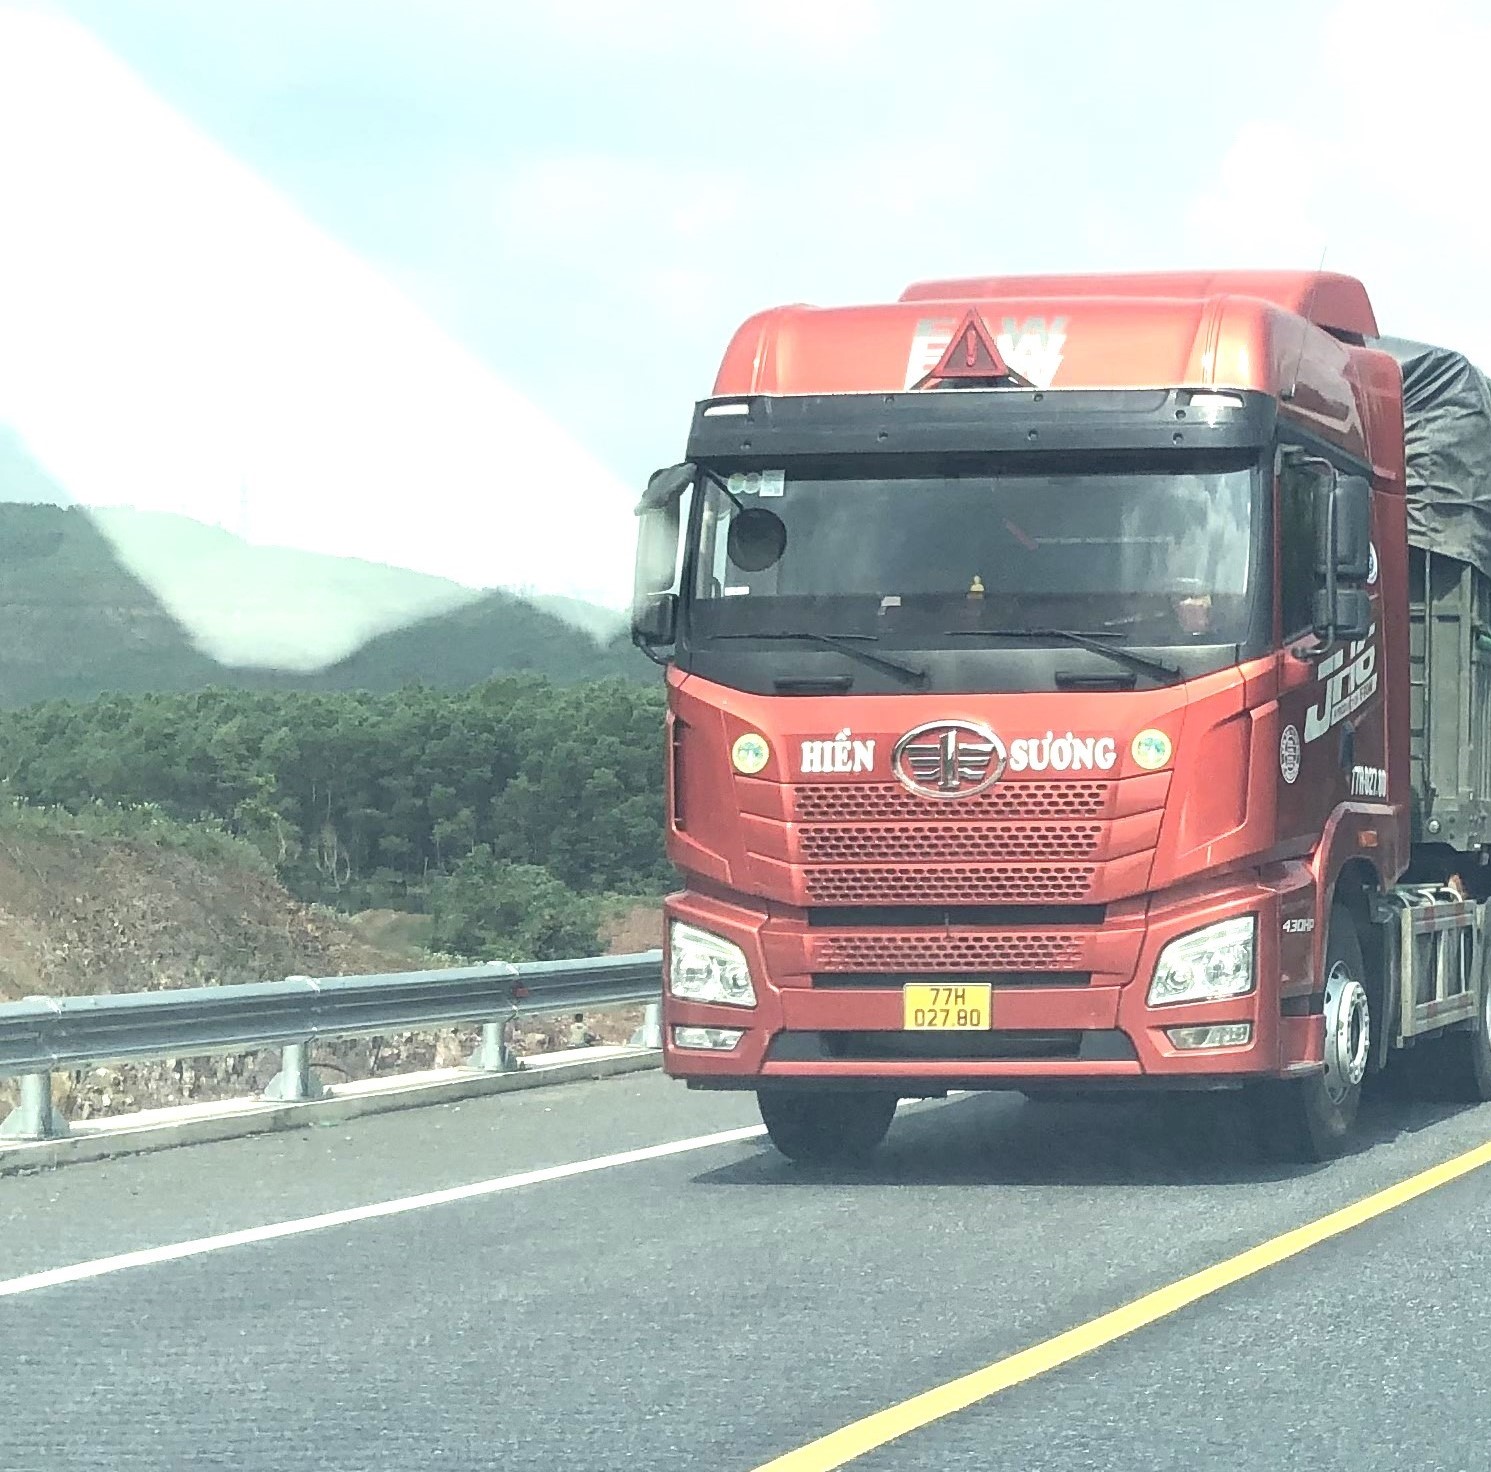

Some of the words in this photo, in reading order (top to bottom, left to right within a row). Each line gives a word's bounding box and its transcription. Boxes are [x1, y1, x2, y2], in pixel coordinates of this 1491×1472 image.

[1009, 730, 1117, 771] SƯƠNG
[1282, 918, 1315, 933] 430HP
[930, 987, 966, 1006] 77H
[914, 1008, 981, 1027] 027.80
